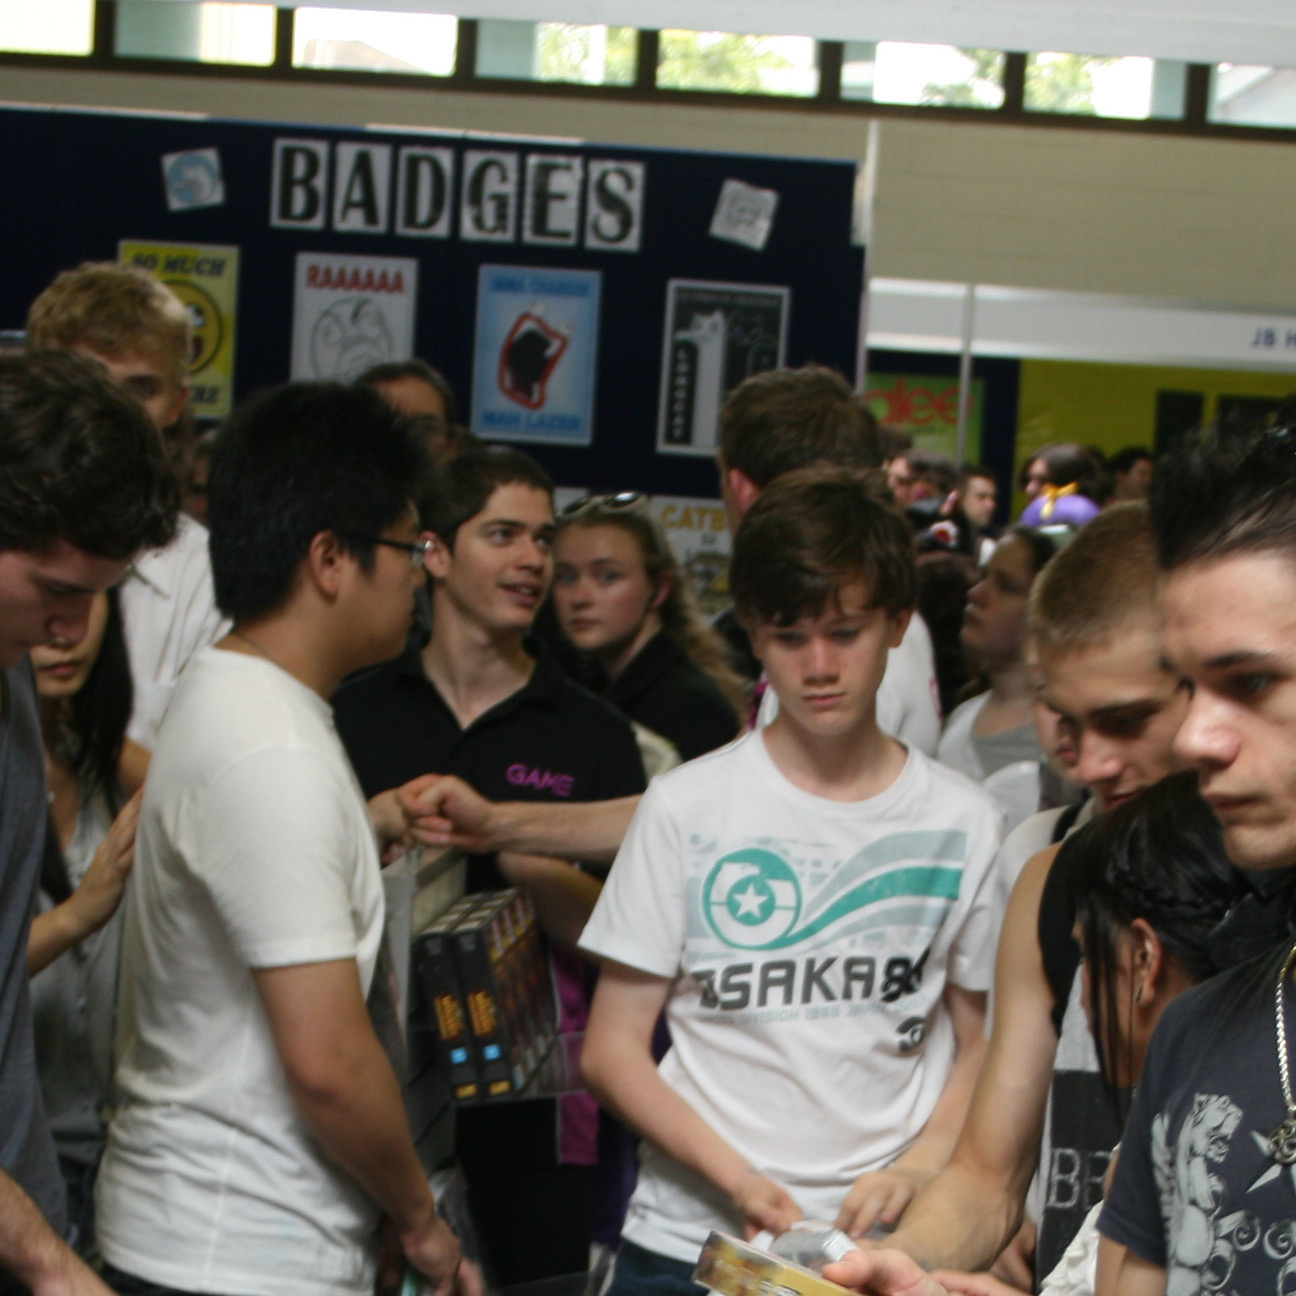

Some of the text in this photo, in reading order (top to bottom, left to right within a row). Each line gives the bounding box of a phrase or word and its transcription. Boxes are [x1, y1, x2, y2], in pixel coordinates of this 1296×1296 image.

[280, 145, 638, 243] BADGES
[162, 255, 226, 277] MUCH
[1251, 327, 1276, 347] JB
[506, 764, 575, 797] GAME
